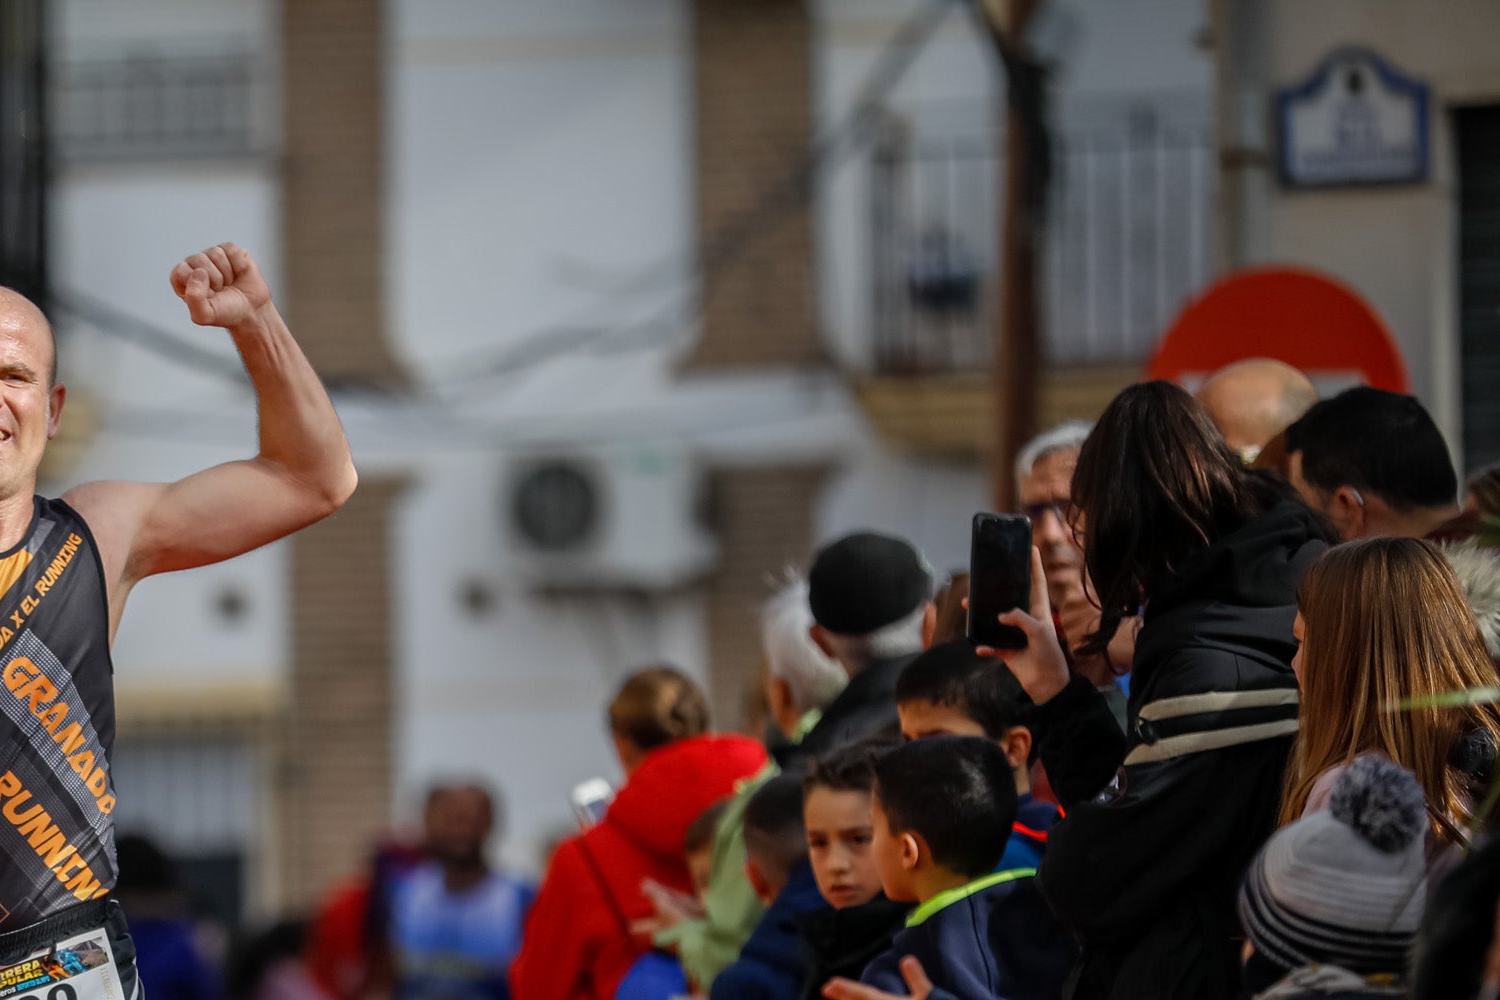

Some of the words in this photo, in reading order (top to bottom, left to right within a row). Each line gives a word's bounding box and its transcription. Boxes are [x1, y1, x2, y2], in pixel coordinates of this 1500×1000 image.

[10, 610, 25, 629] X
[20, 595, 40, 617] EL
[34, 532, 83, 597] RUNNING
